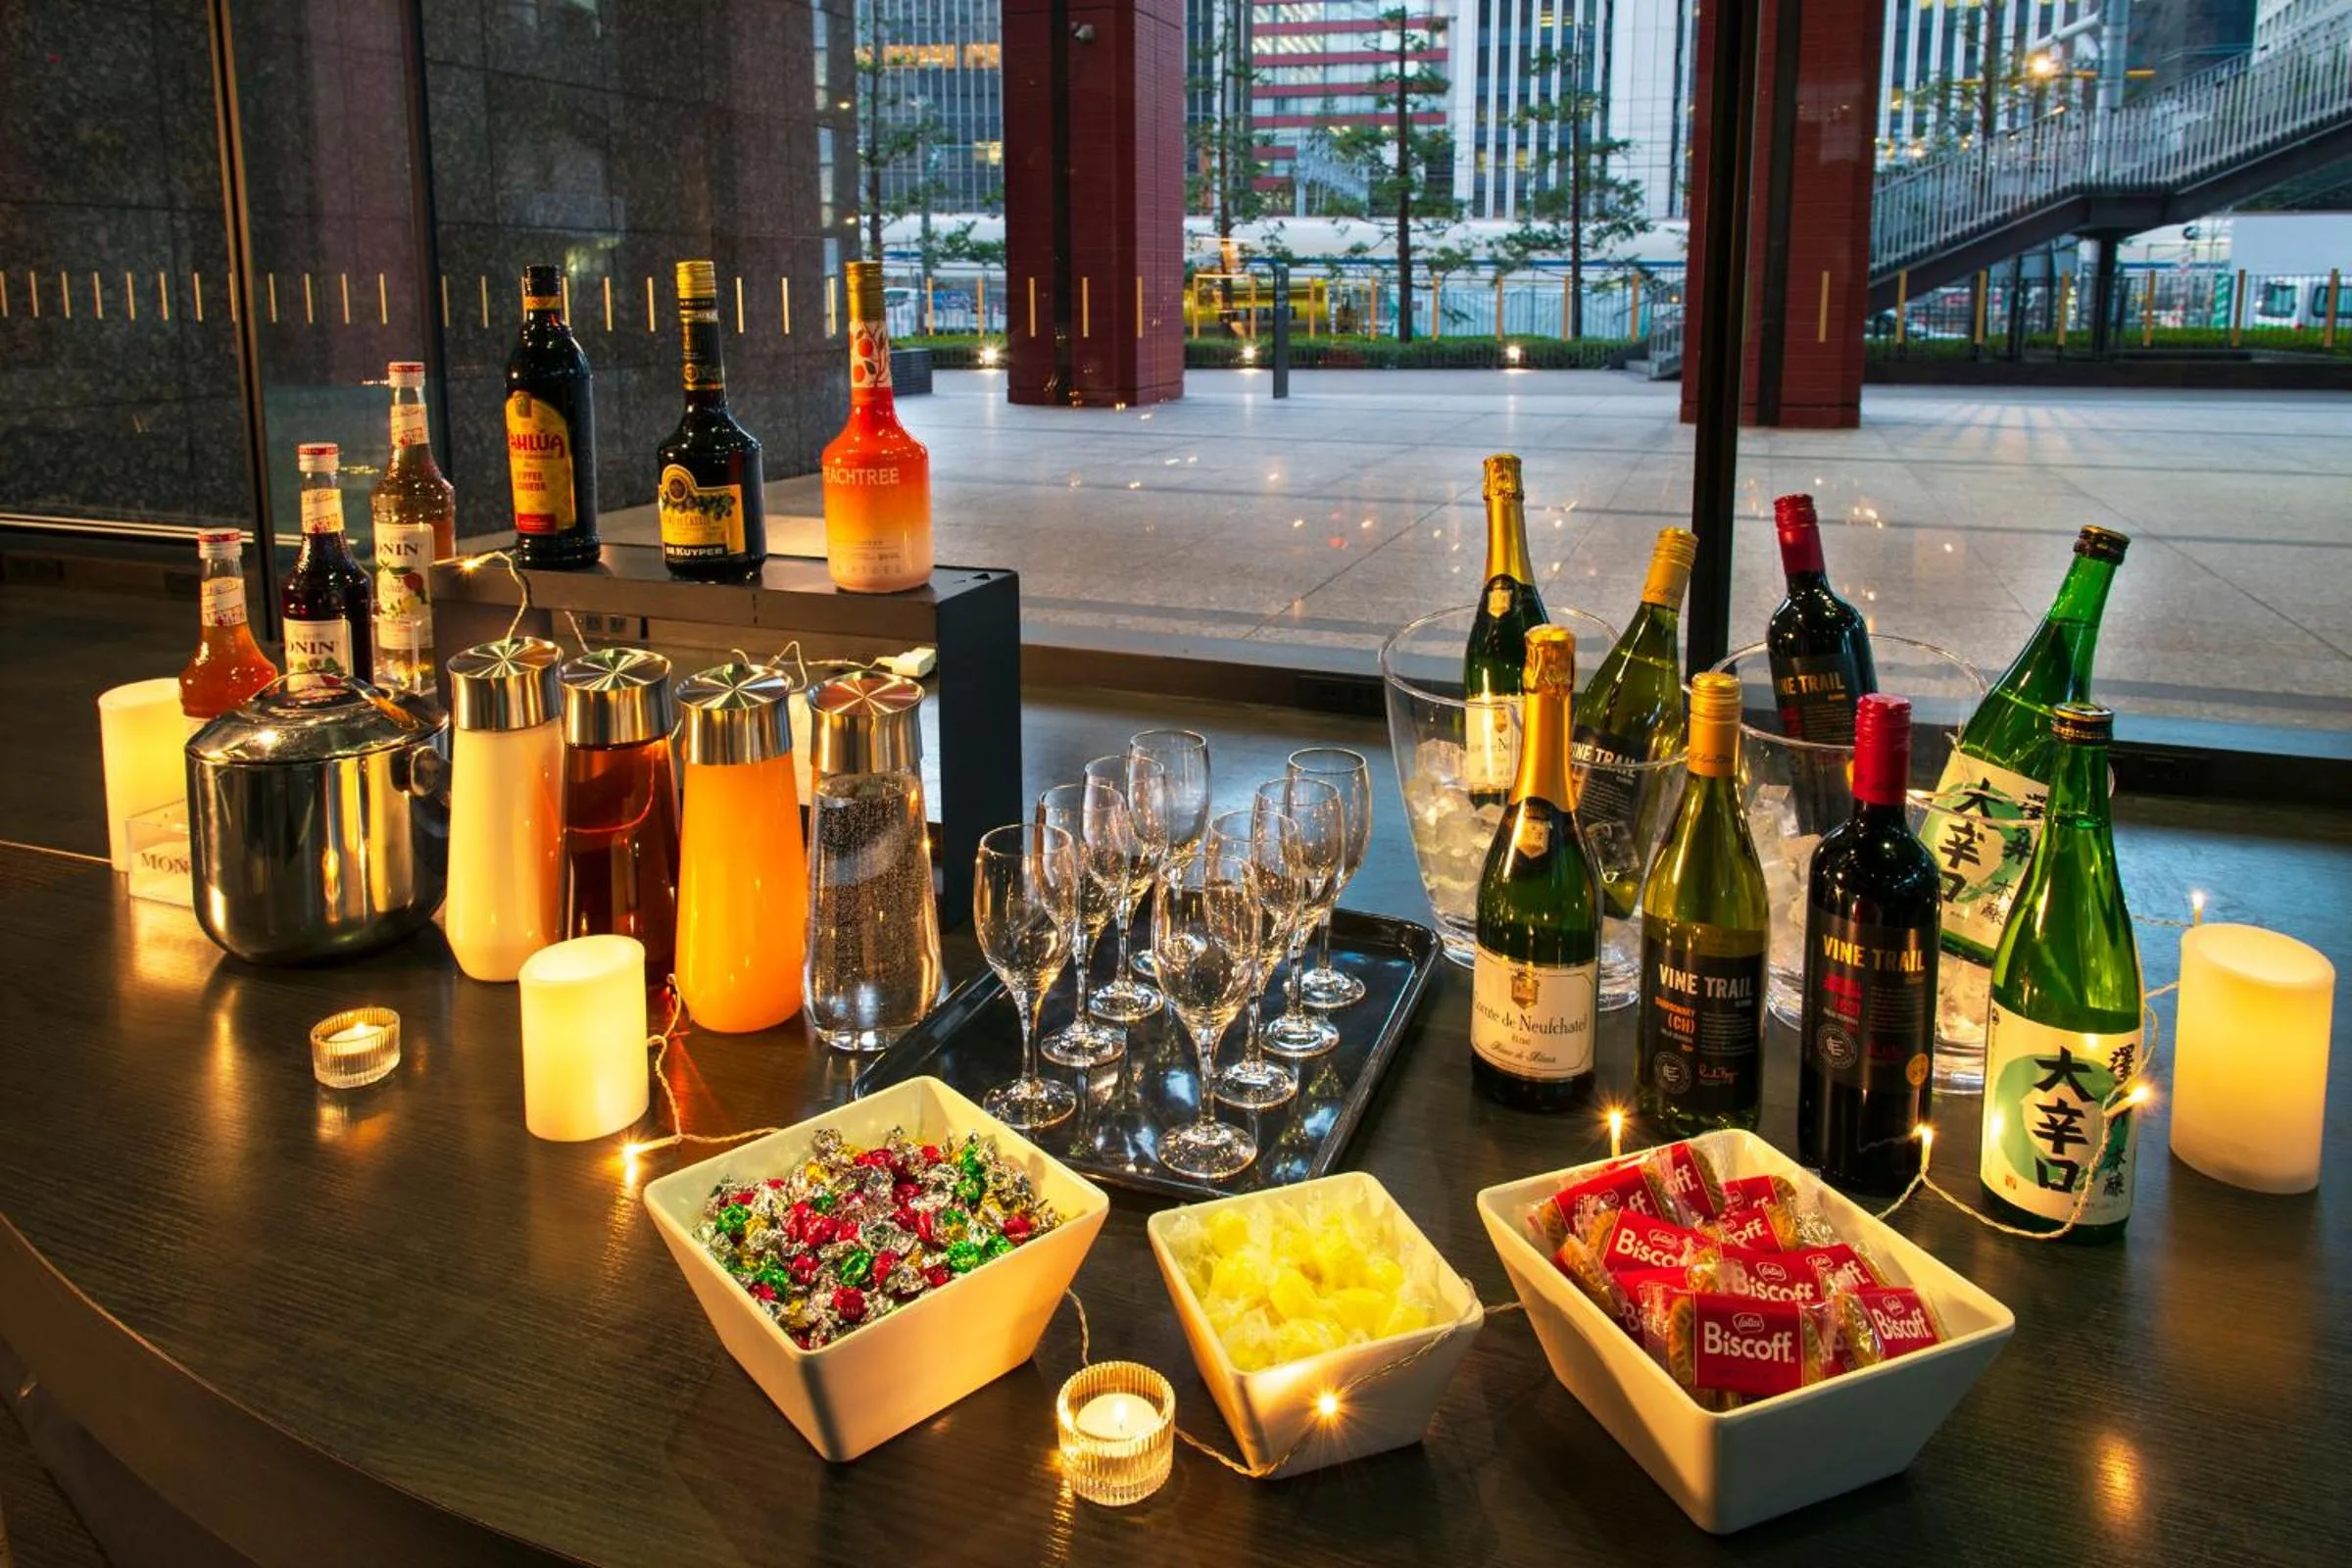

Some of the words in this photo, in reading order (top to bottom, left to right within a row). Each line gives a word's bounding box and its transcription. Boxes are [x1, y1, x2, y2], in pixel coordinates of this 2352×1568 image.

[1797, 671, 1845, 695] TRAIL
[141, 852, 190, 875] MON
[1824, 934, 1866, 969] VINE
[1871, 948, 1926, 973] TRAIL
[1659, 963, 1699, 996] VINE
[1703, 977, 1754, 1000] TRAIL
[1615, 1227, 1688, 1269] Bisco
[1734, 1266, 1814, 1301] Biscoff
[1703, 1320, 1793, 1363] Biscoff
[1871, 1306, 1929, 1341] Biscoff
